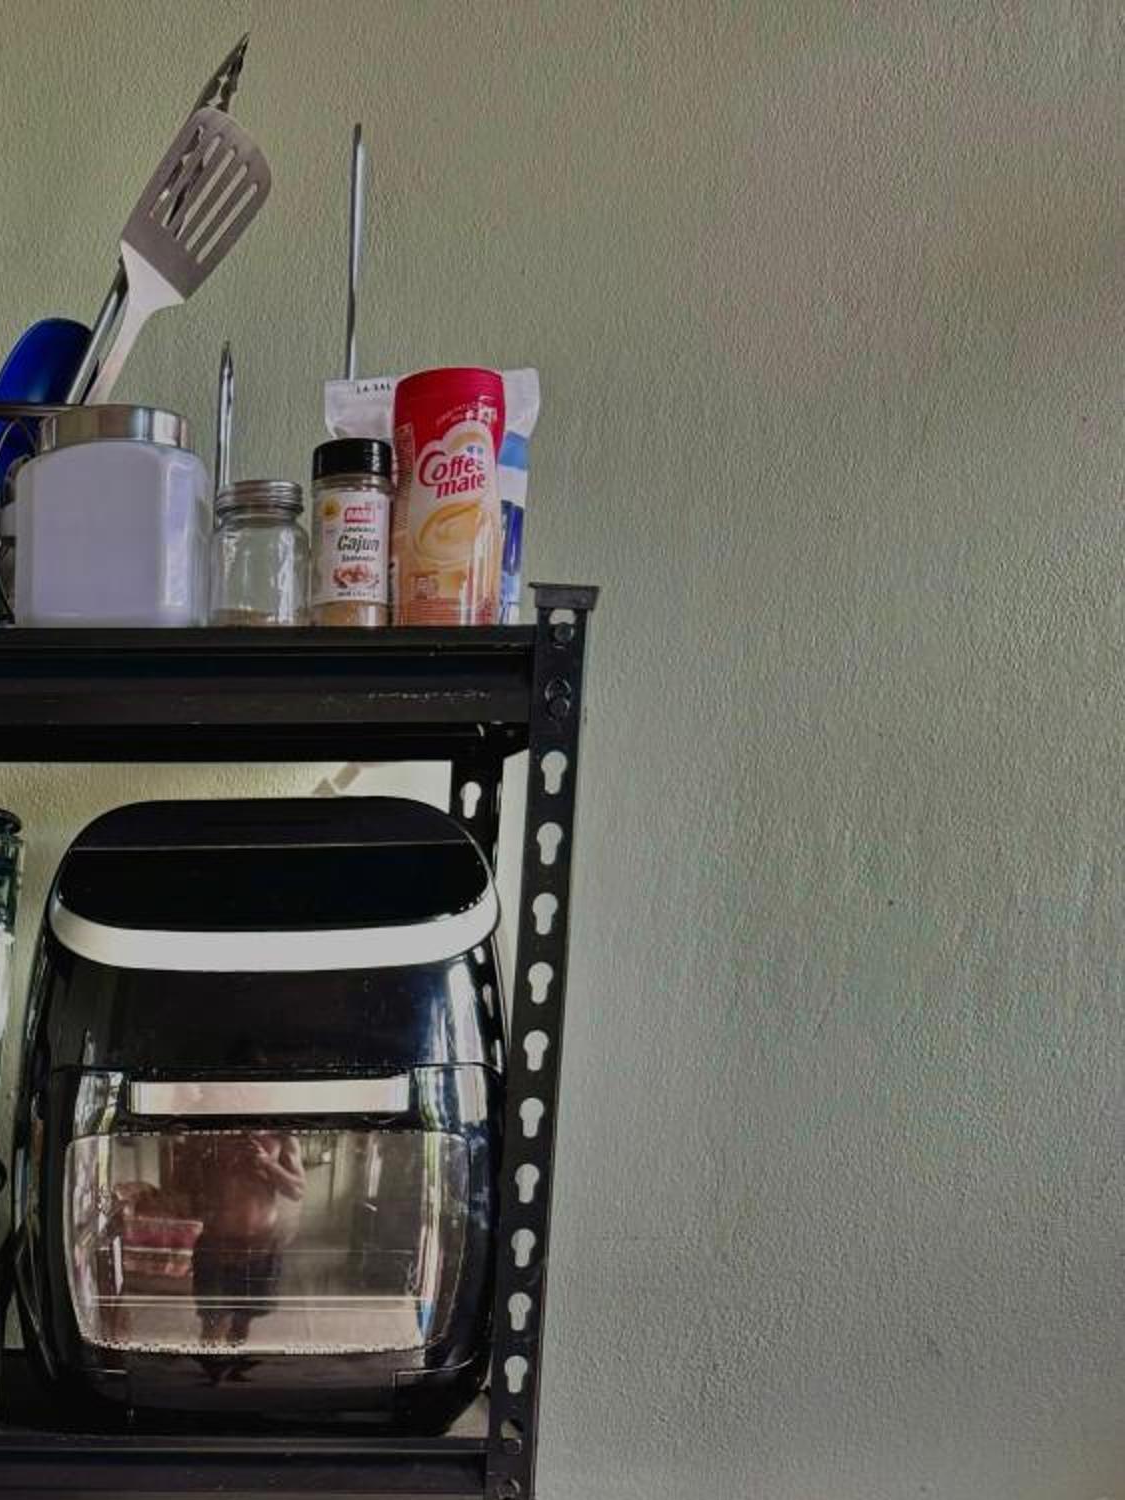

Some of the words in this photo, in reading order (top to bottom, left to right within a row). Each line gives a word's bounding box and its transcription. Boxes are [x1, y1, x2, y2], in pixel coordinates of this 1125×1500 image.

[418, 450, 484, 488] Coffee
[436, 473, 485, 499] mate
[337, 534, 380, 553] Cajun
